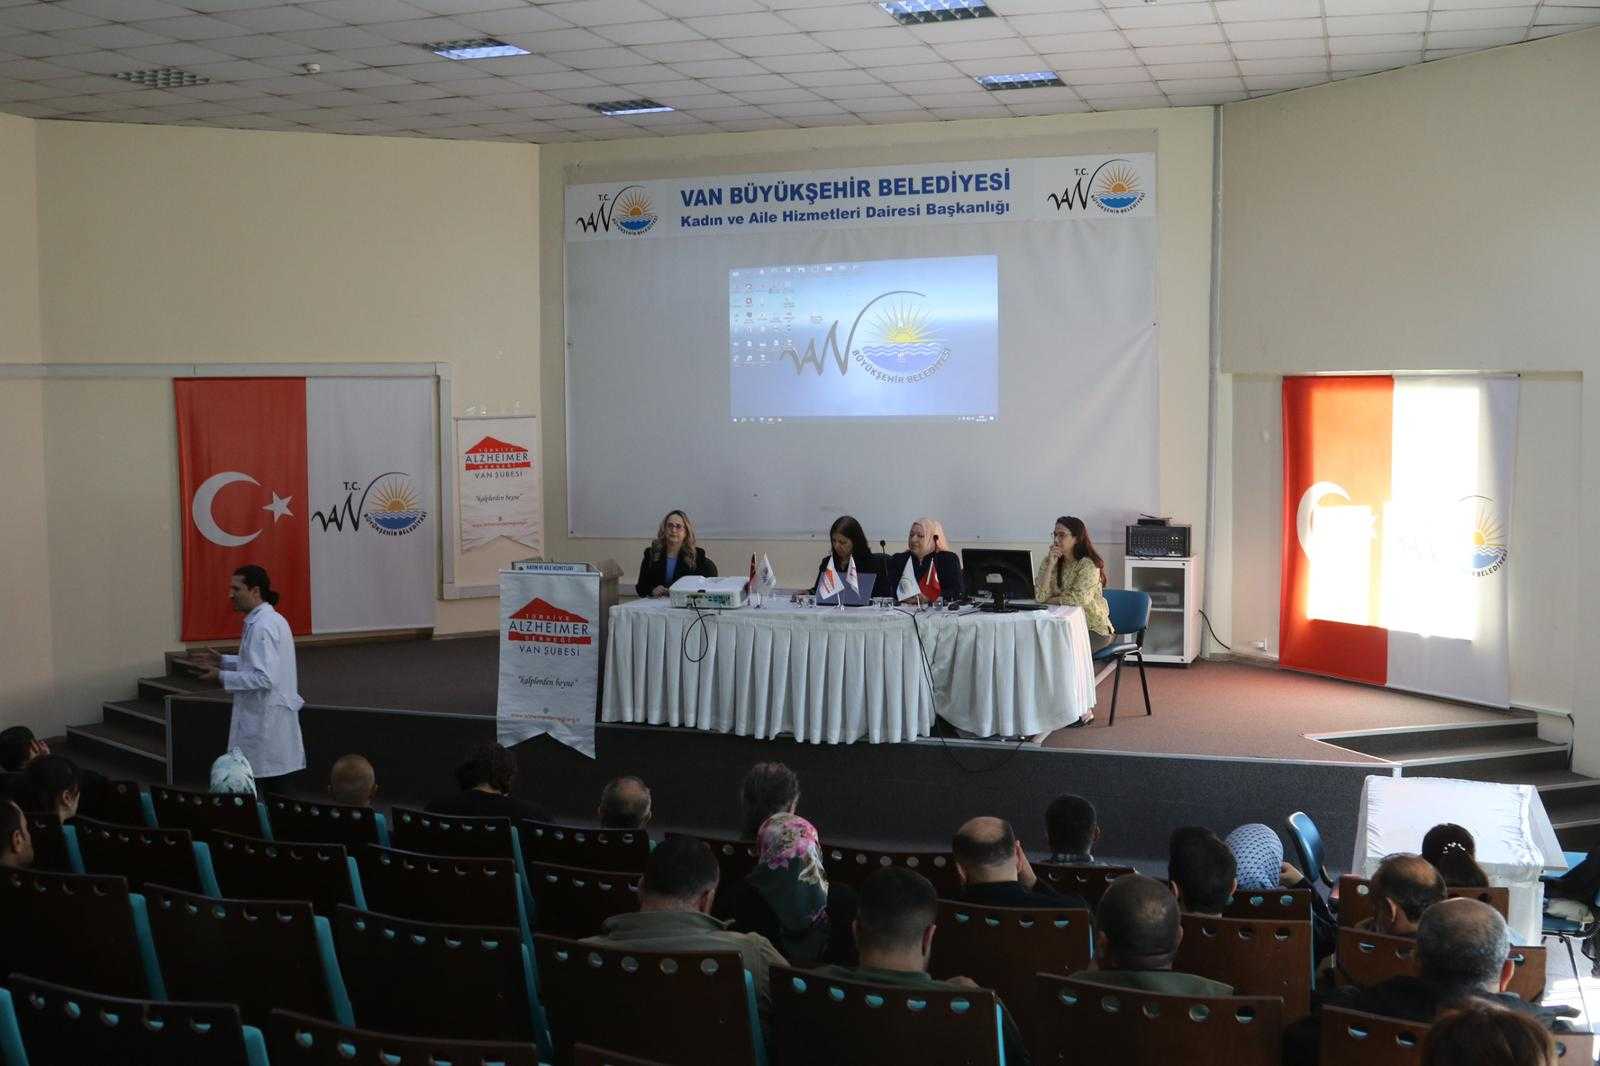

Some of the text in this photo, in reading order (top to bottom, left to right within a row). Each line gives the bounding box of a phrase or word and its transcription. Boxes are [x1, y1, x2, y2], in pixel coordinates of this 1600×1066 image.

[680, 168, 1010, 208] VAN BÜYÜKŞEHİR BELEDİYESİ
[681, 200, 1010, 228] Kadın ve Aile Hizmetleri Dairesi Başkanlığı
[465, 453, 529, 462] ALZHEIMER
[474, 471, 493, 479] VAN
[343, 482, 361, 490] T.C.
[509, 620, 589, 635] ALZHEIMER
[520, 645, 540, 653] VAN
